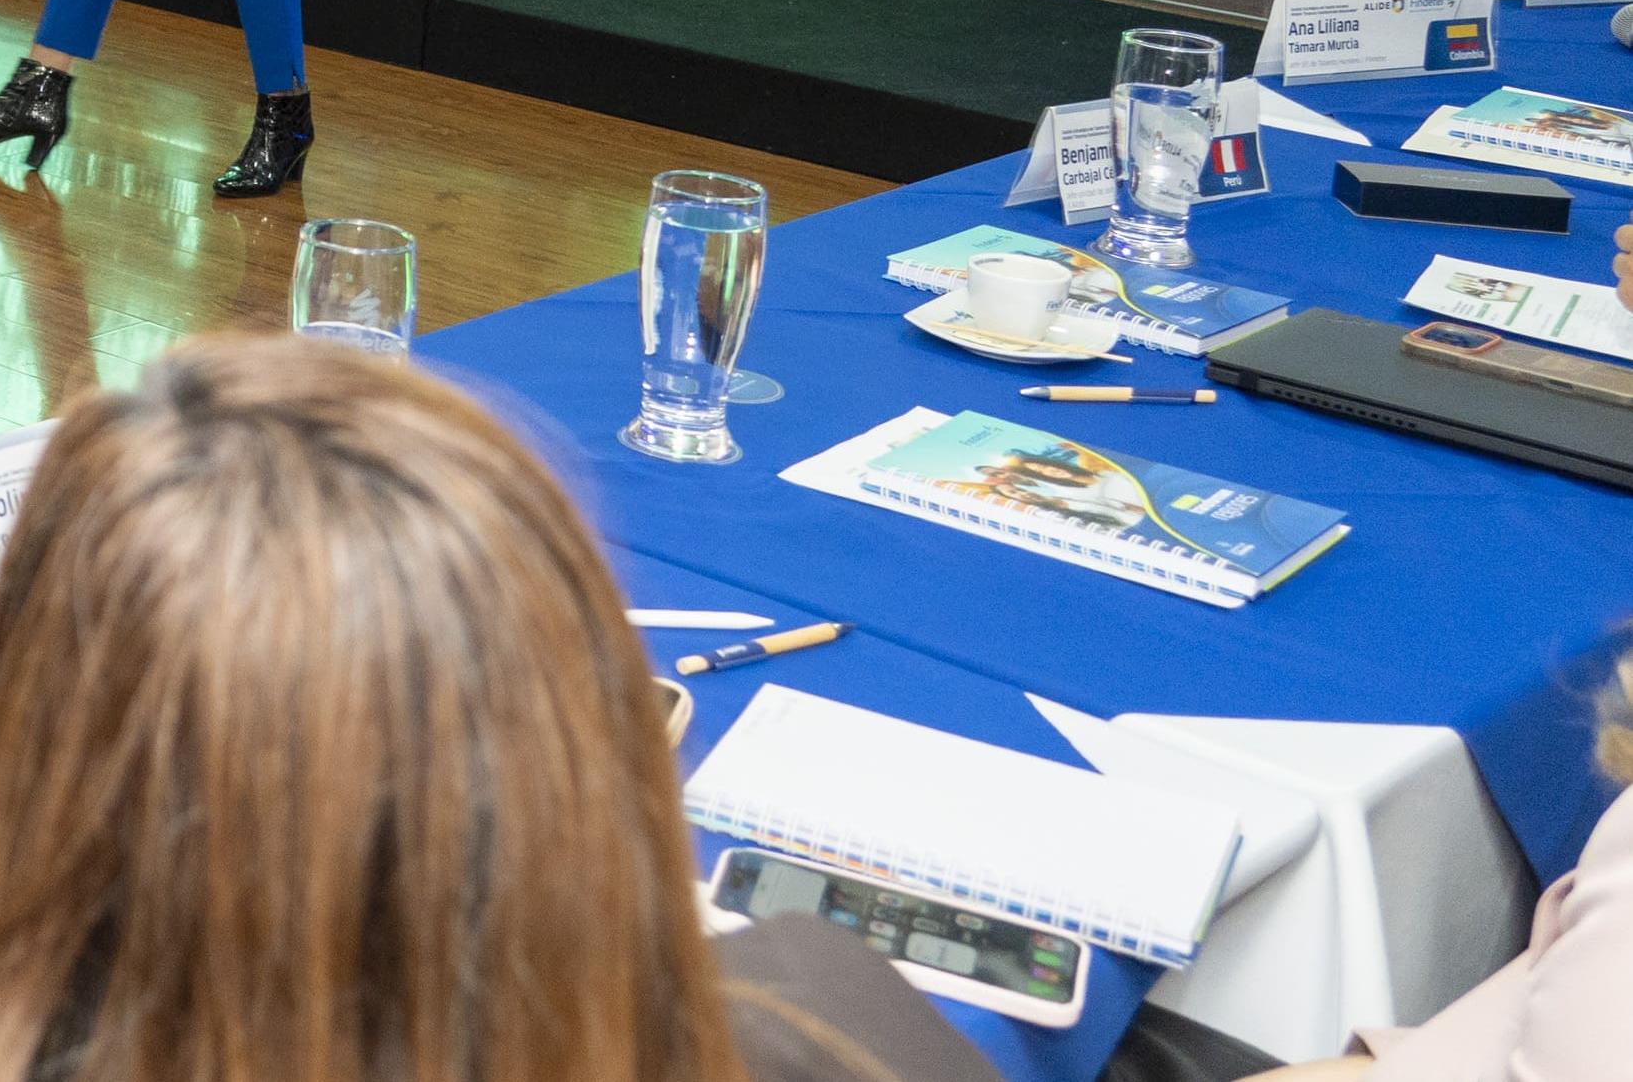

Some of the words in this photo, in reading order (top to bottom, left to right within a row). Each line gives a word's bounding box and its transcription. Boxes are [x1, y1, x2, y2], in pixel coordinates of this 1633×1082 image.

[1364, 2, 1390, 11] ALIDE
[1289, 21, 1314, 36] Ana
[1318, 18, 1359, 34] Liliana
[1327, 39, 1359, 52] Murcia
[1062, 142, 1114, 169] Benjami
[1063, 168, 1102, 187] Carbajal
